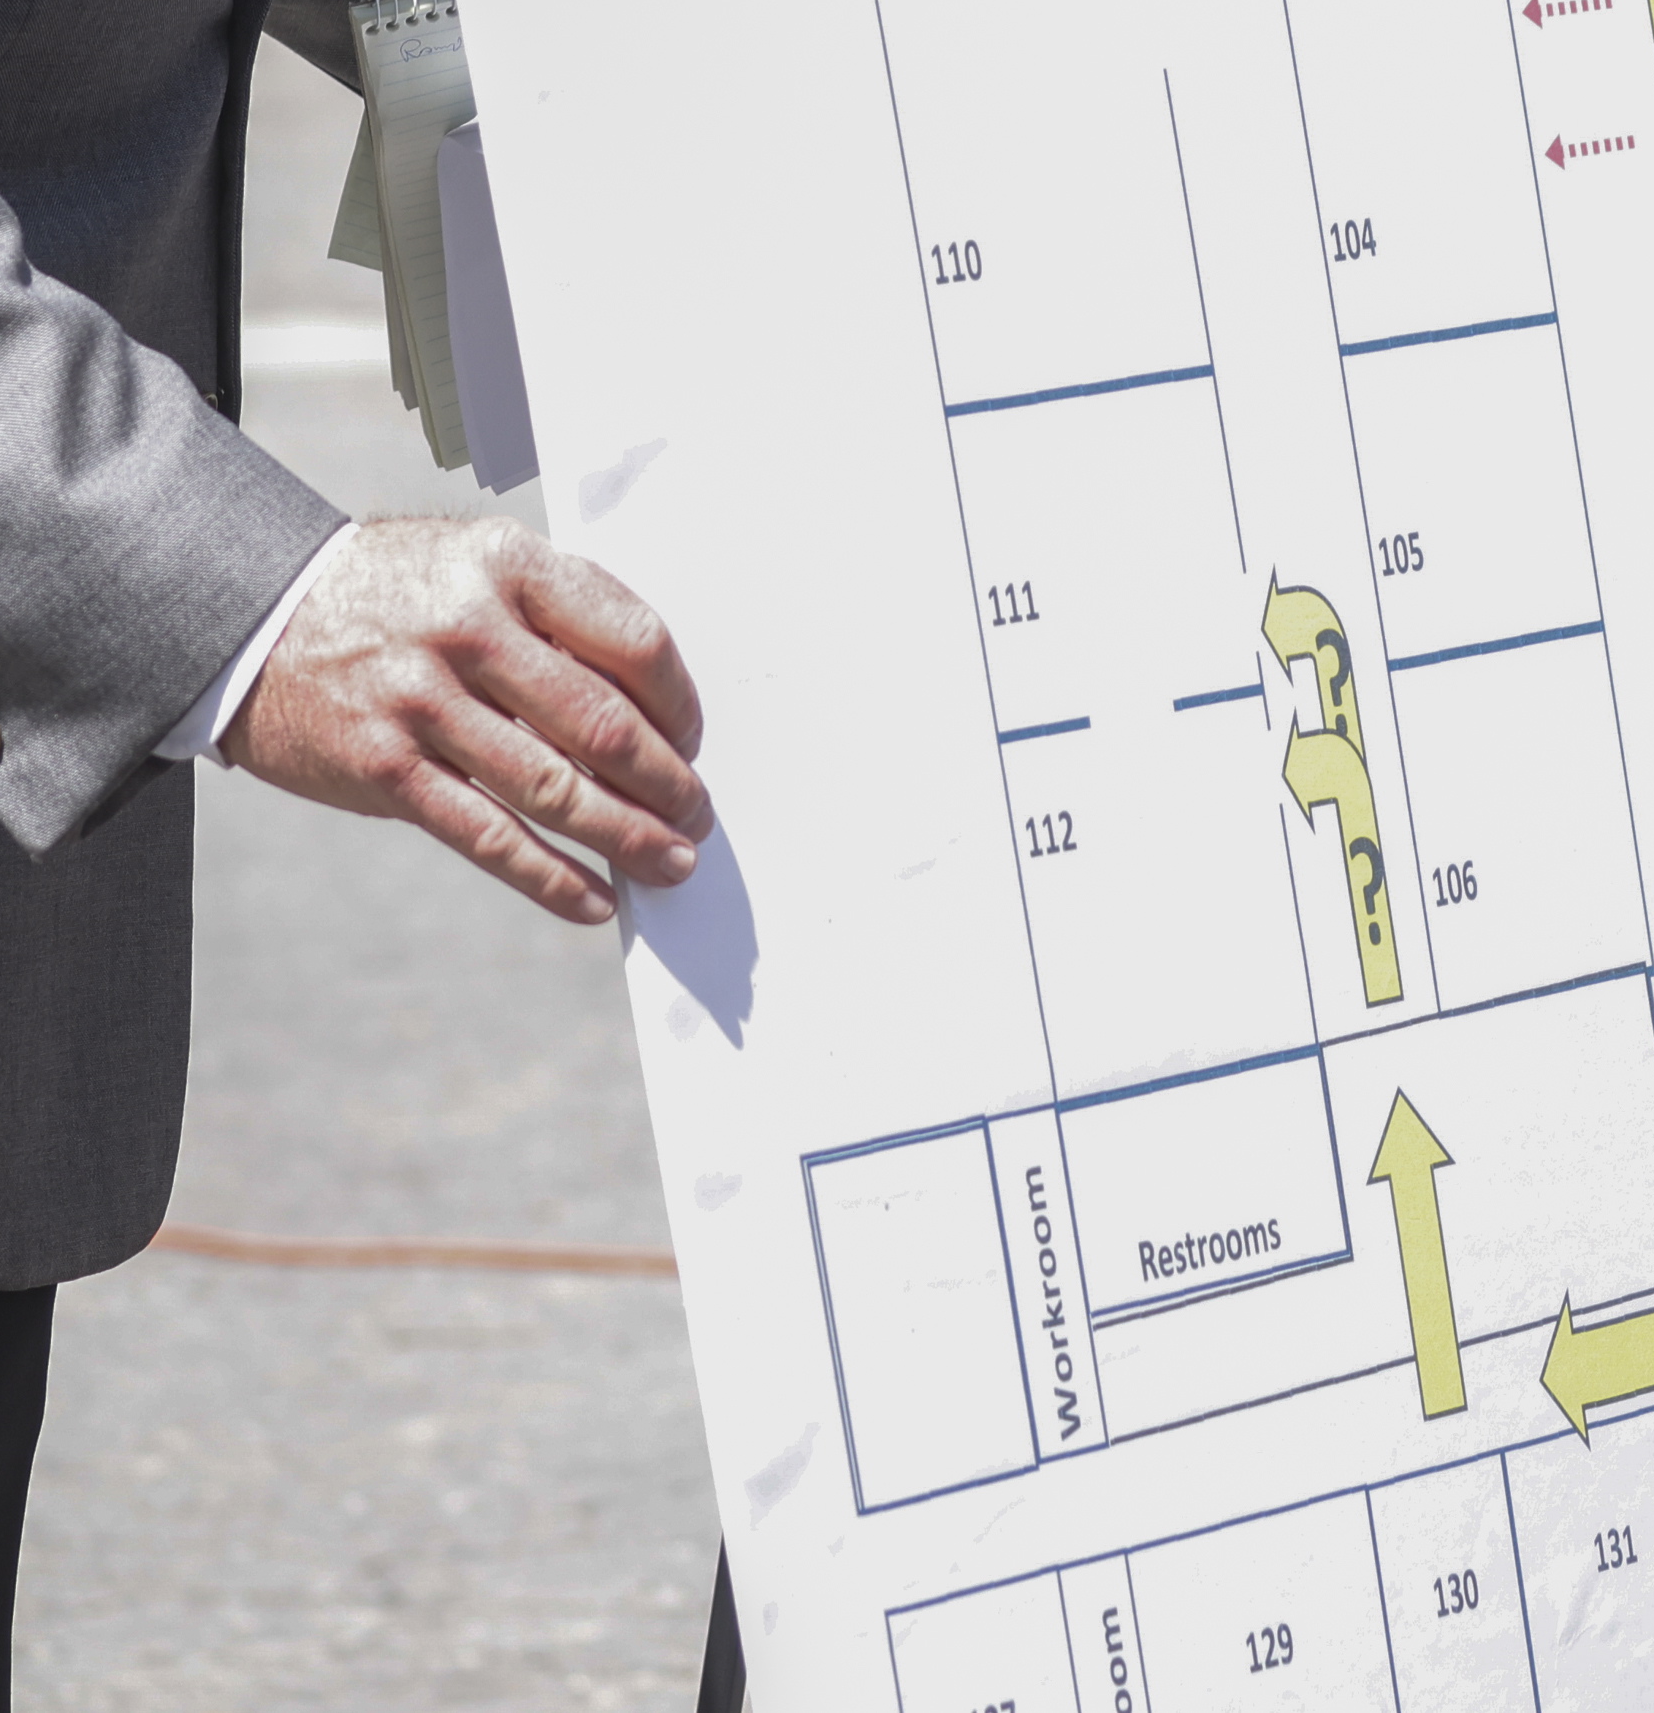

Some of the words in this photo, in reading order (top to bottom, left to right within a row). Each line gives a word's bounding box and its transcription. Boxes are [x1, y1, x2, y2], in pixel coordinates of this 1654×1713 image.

[930, 238, 984, 287] 110
[1328, 216, 1378, 264] 104
[1377, 530, 1426, 578] 105
[987, 579, 1041, 628] 111
[1315, 629, 1350, 737] ?
[1024, 809, 1079, 860] 112
[1349, 837, 1384, 947] ?
[1431, 858, 1479, 909] 106
[1137, 1217, 1283, 1284] Restrooms
[1025, 1166, 1081, 1441] Workroom
[1592, 1523, 1640, 1574] 131
[1432, 1567, 1480, 1620] 130
[1244, 1621, 1295, 1675] 129
